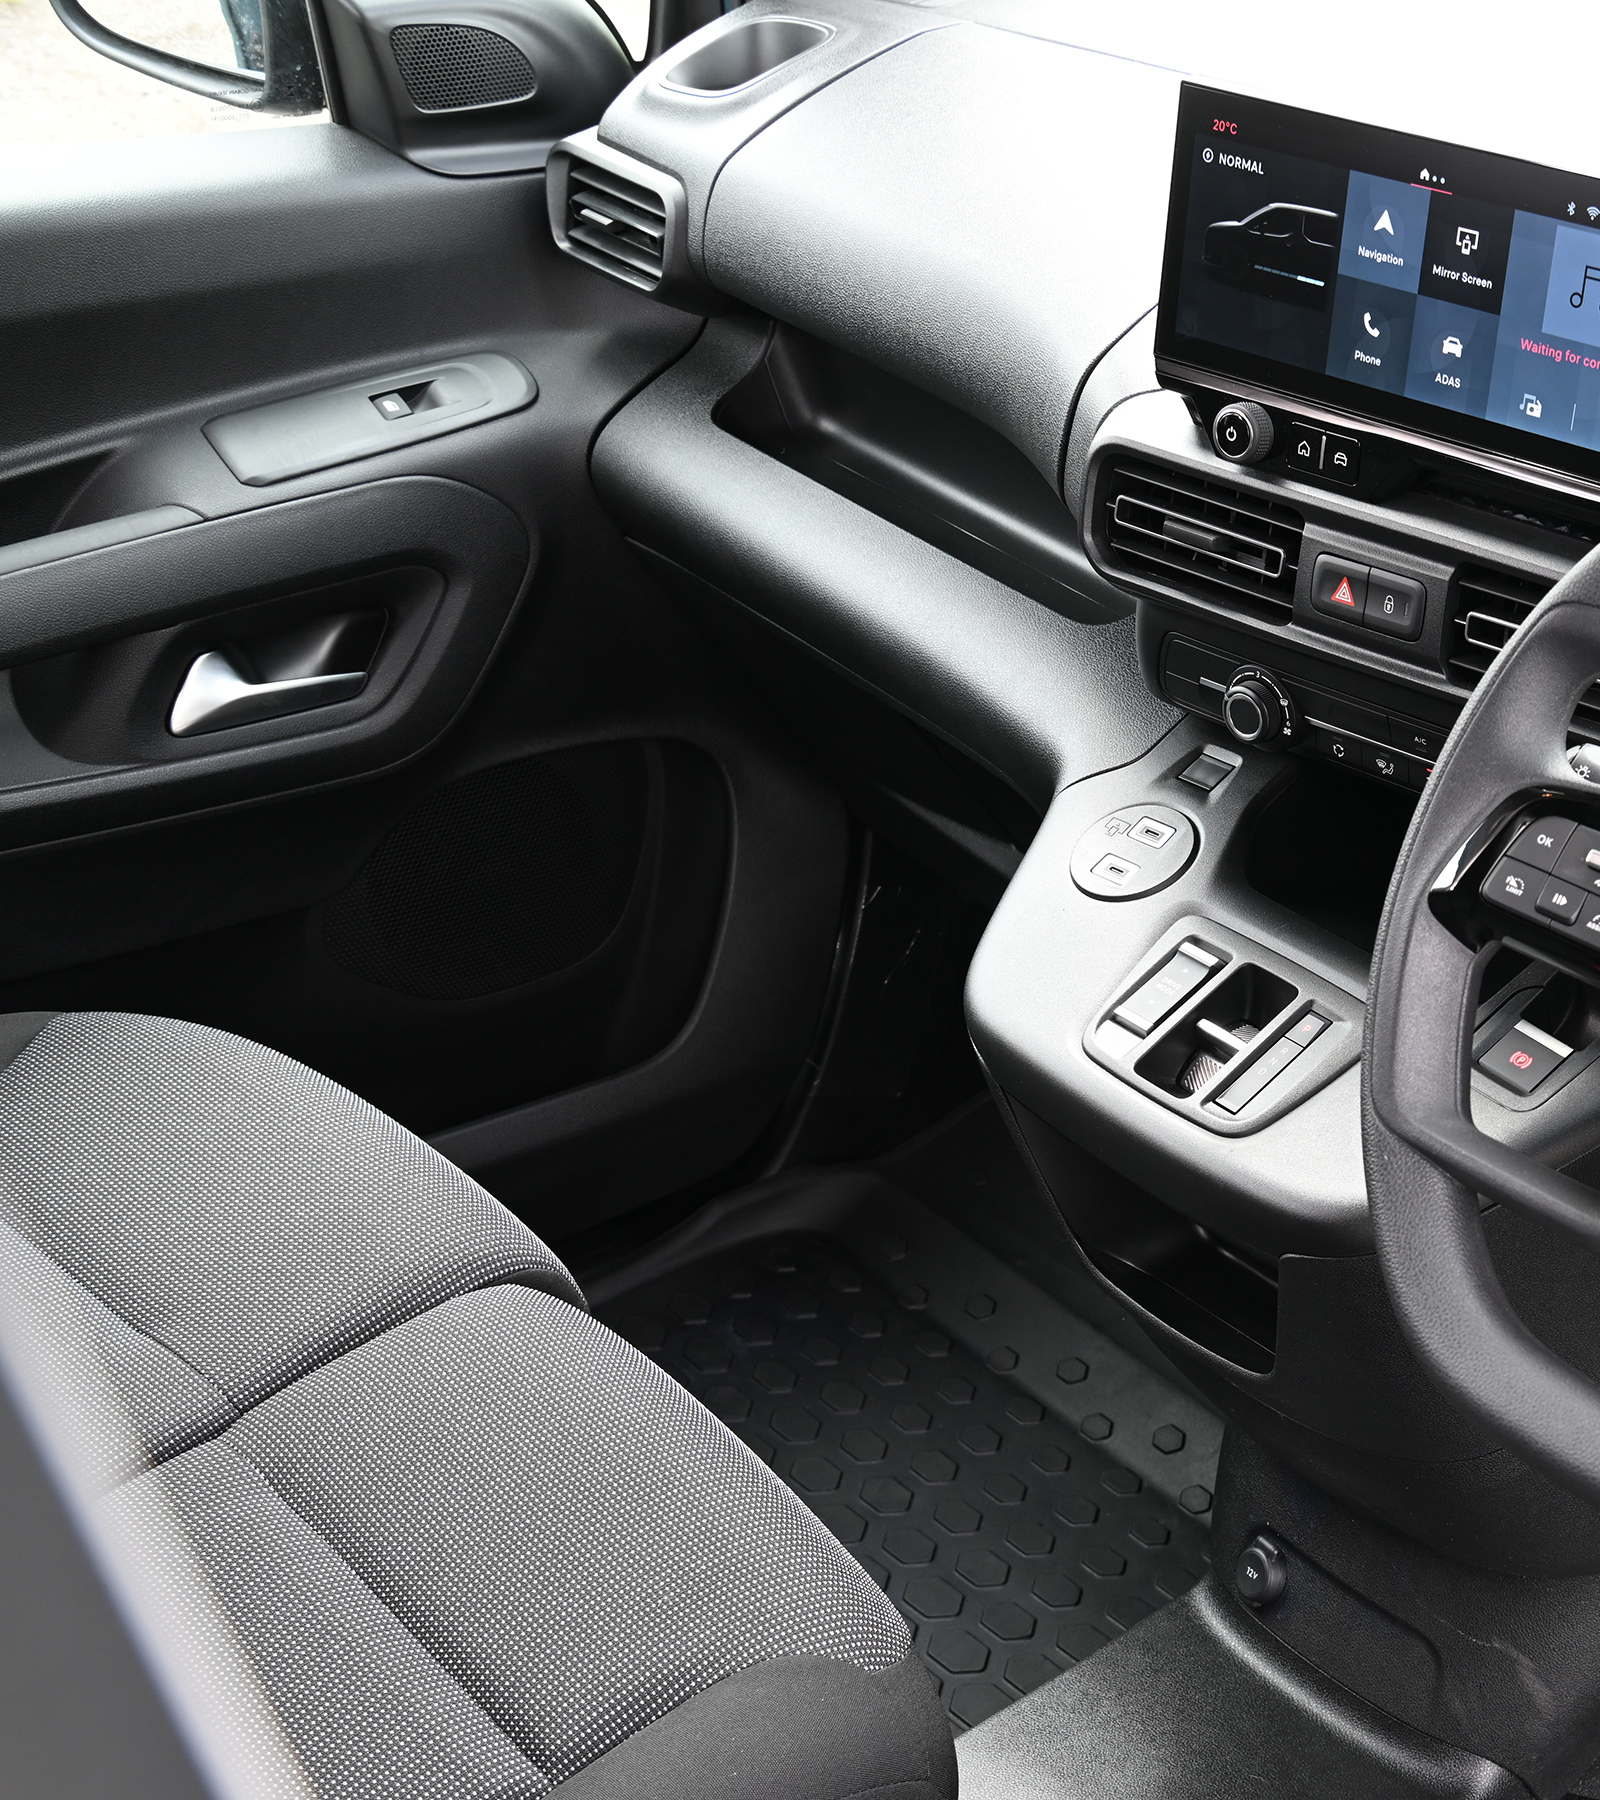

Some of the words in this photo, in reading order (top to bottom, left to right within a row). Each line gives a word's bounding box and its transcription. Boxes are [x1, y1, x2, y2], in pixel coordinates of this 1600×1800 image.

[1212, 118, 1238, 135] 20°C
[1218, 152, 1264, 175] NORMAL
[1357, 245, 1404, 267] Navigation
[1432, 264, 1461, 281] Mirror
[1461, 271, 1493, 289] Screen
[1354, 349, 1382, 367] Phone
[1520, 337, 1563, 363] Waiting
[1565, 349, 1582, 364] for
[1434, 372, 1461, 389] ADAS
[1255, 670, 1261, 679] 3
[1414, 736, 1427, 746] A/C
[1536, 833, 1554, 848] OK
[1505, 884, 1524, 897] LIMIT
[1154, 982, 1177, 997] MODE
[1161, 976, 1183, 991] DRIVE
[1301, 1024, 1312, 1032] P
[1279, 1047, 1289, 1055] R
[1268, 1057, 1279, 1066] N
[1257, 1067, 1267, 1075] D
[1246, 1566, 1259, 1580] 12V
